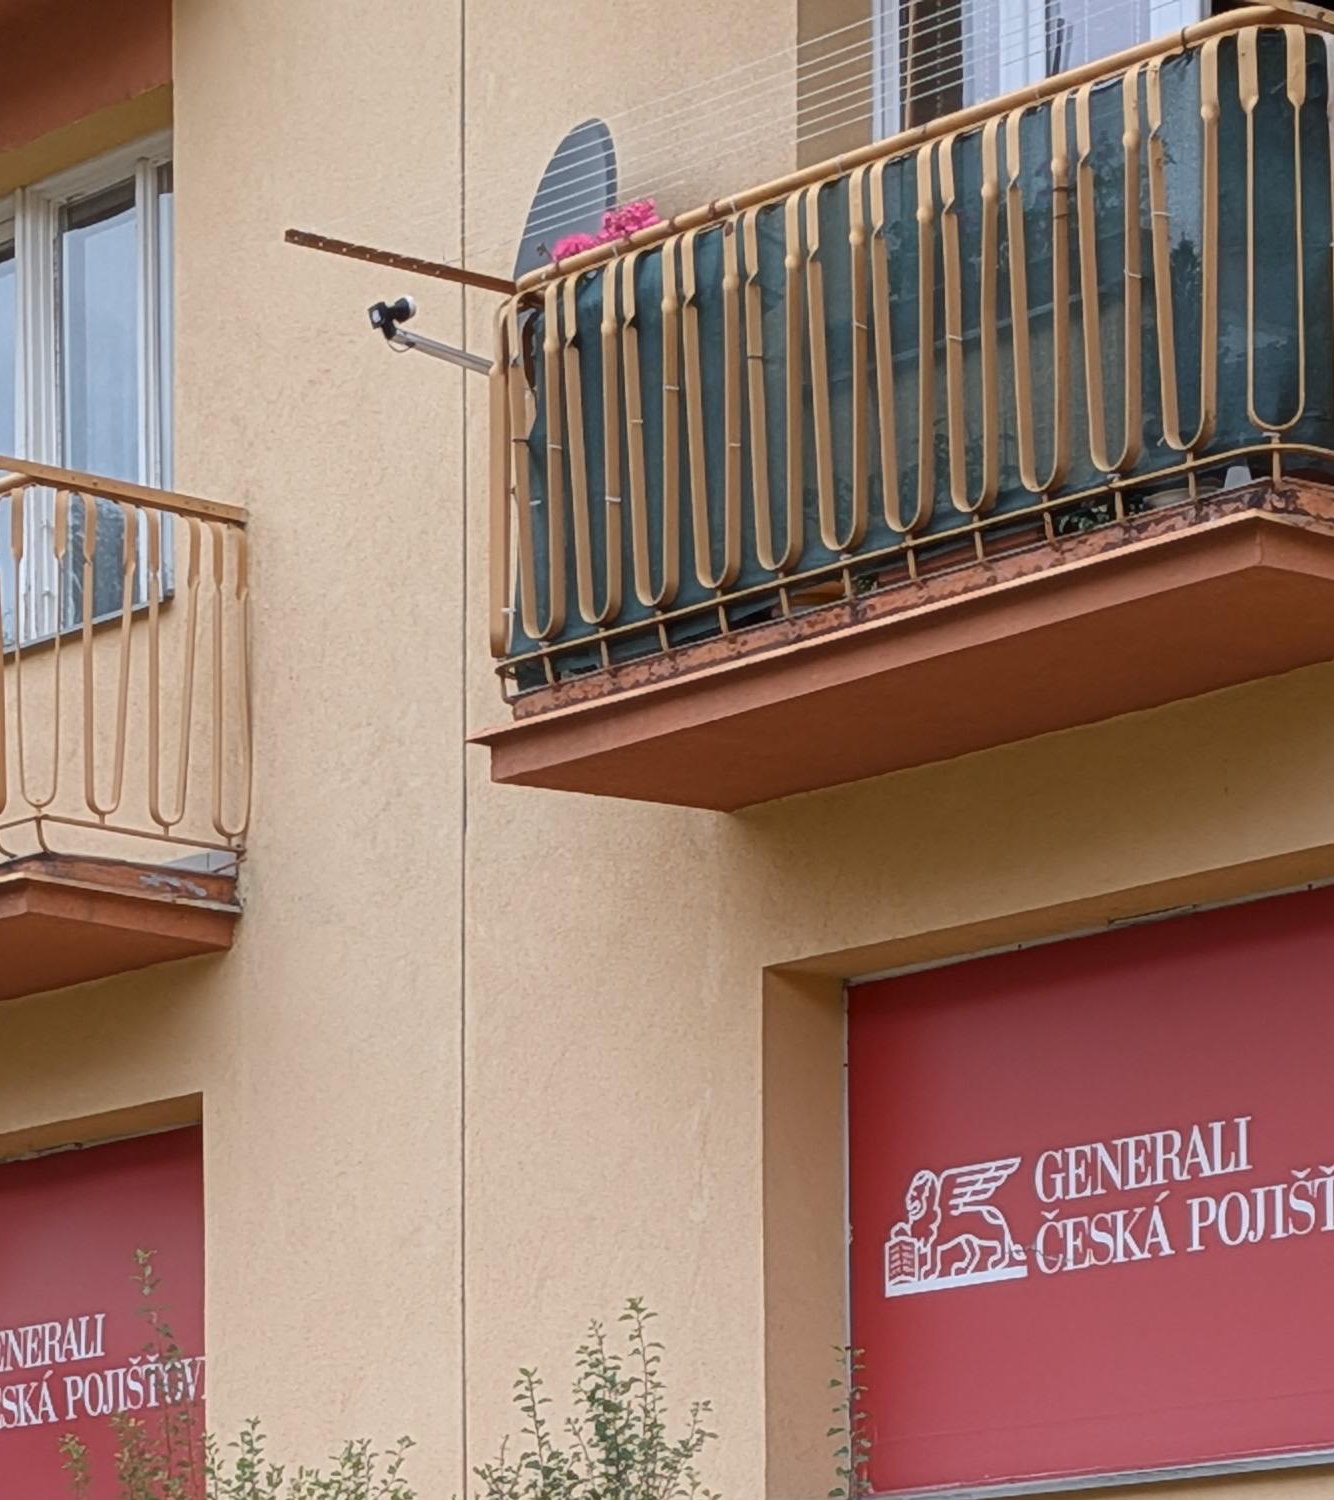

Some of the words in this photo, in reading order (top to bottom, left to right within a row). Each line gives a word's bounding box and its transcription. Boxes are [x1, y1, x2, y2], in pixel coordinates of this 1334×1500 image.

[1034, 1116, 1254, 1204] GENERALI
[1035, 1190, 1177, 1275] ČESKÁ
[62, 1353, 207, 1421] POJIŠŤOV
